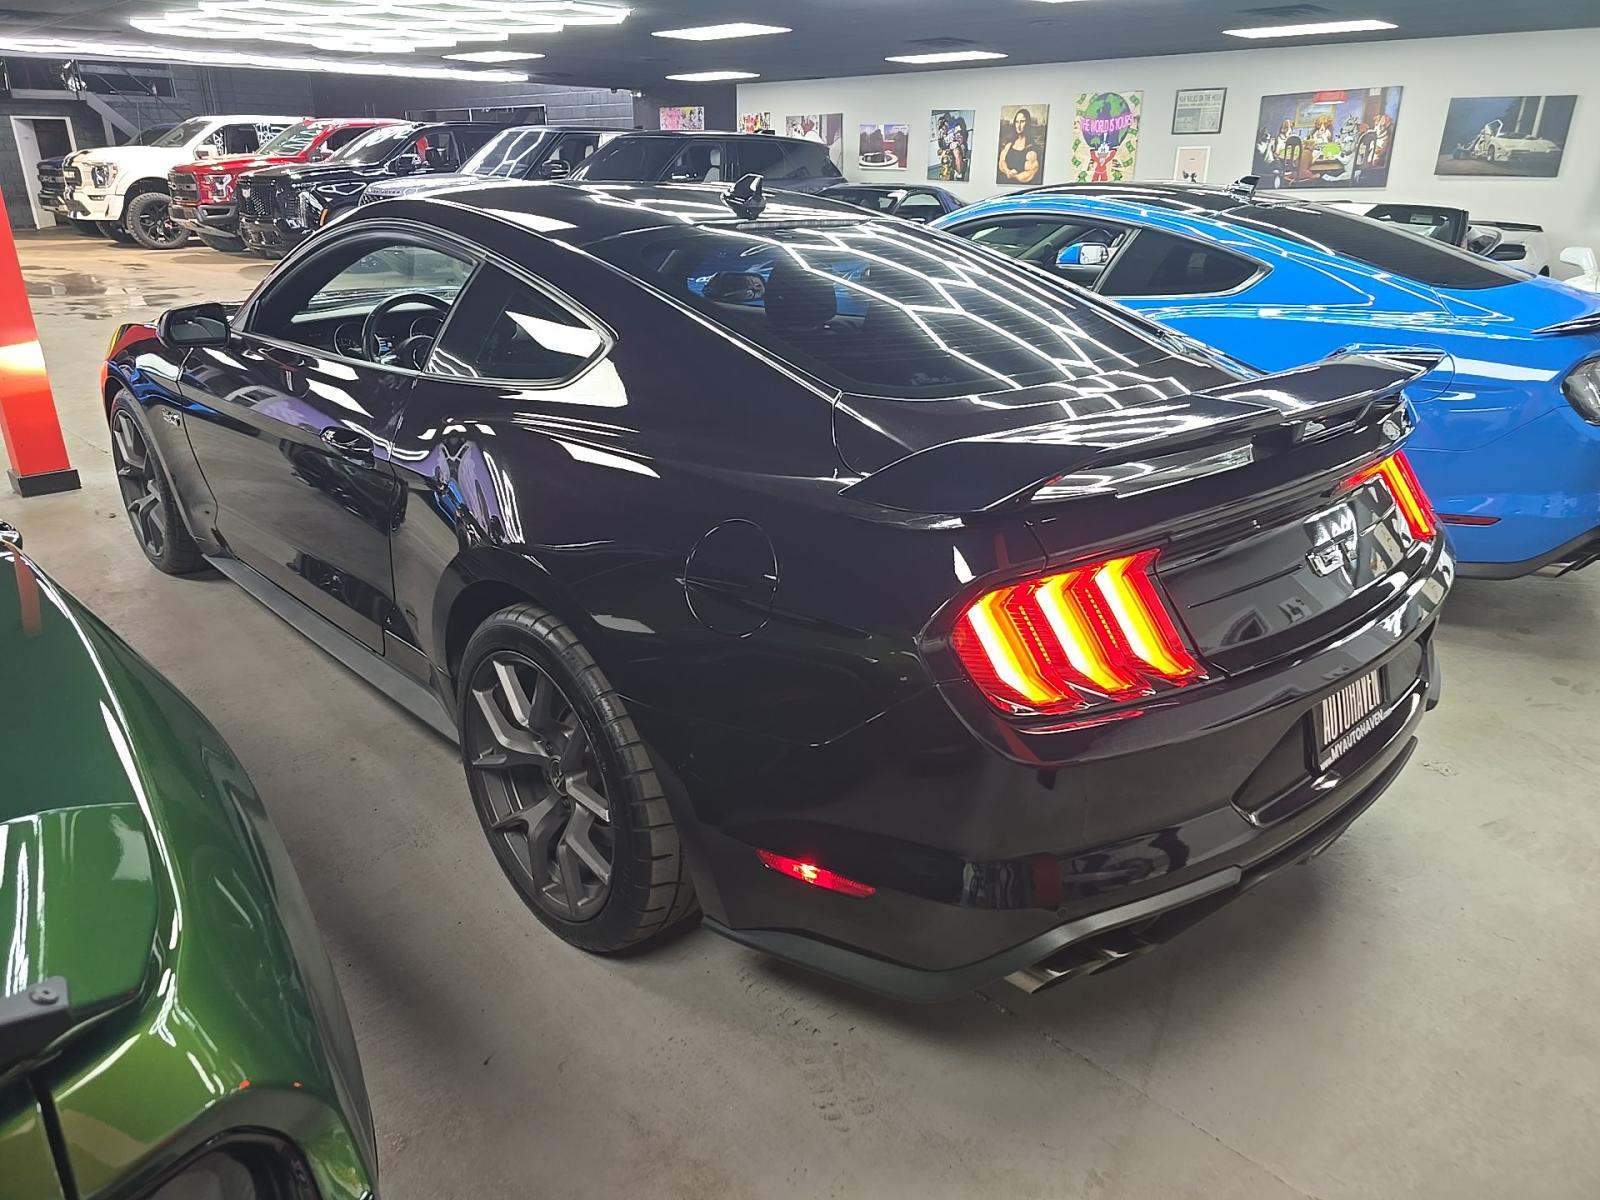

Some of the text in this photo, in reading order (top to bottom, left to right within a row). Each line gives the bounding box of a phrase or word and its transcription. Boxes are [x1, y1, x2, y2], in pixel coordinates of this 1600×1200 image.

[1080, 114, 1133, 133] THE WORLD IS YOURS
[1322, 669, 1381, 745] AUTOHAVEN
